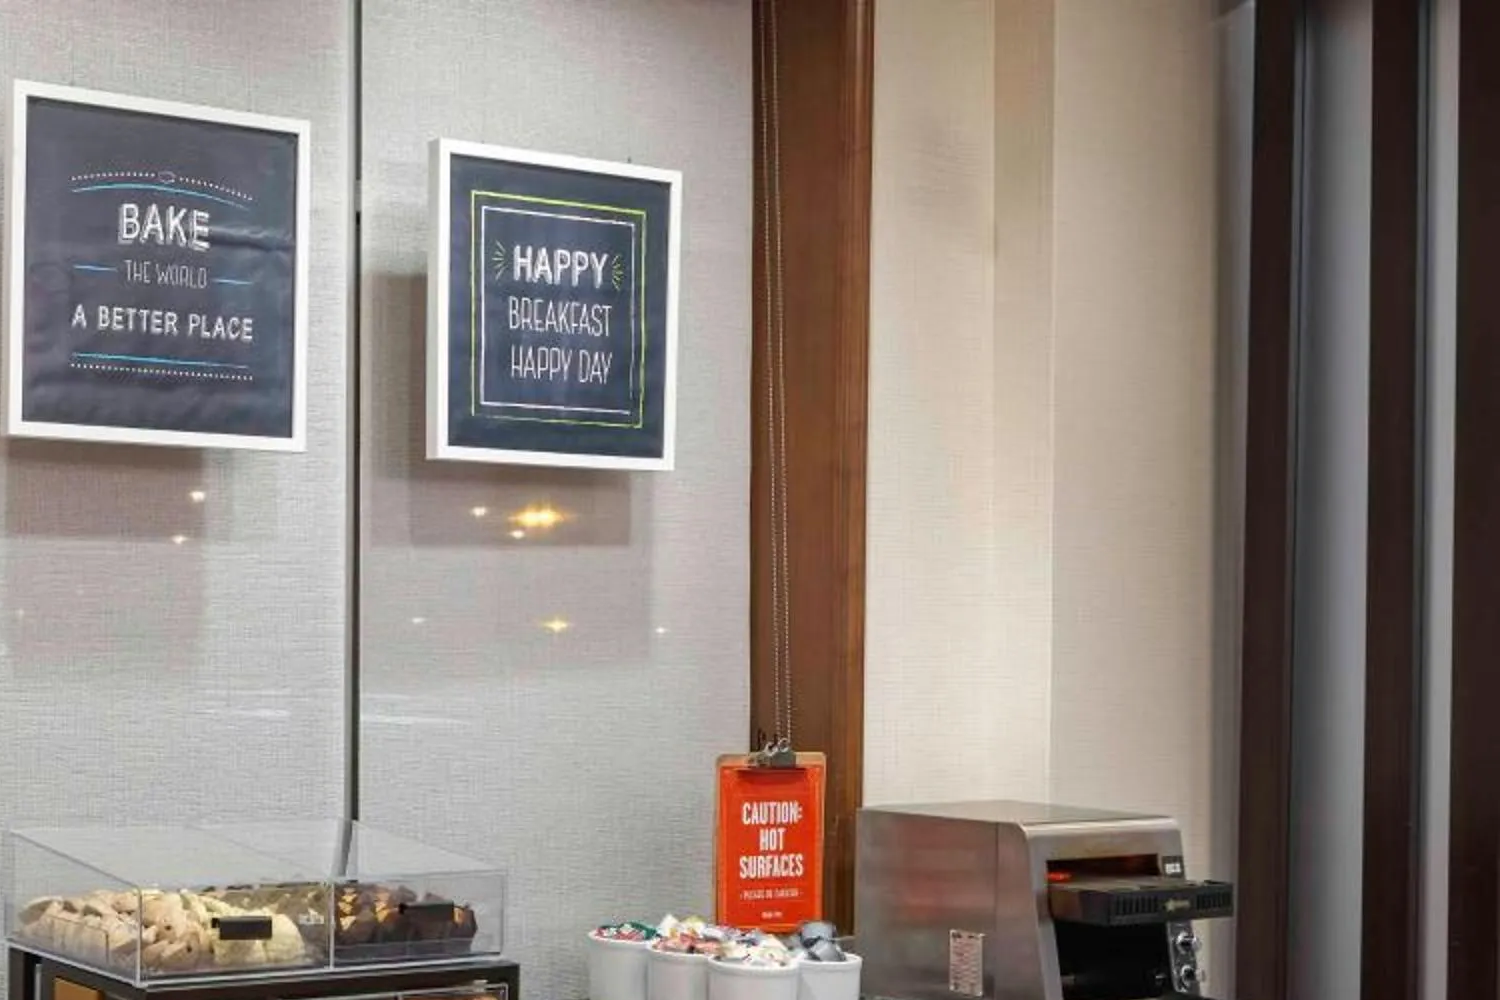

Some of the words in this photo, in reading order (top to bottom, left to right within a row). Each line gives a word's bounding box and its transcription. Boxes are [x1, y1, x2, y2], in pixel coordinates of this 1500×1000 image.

[118, 202, 211, 251] BAKE
[124, 260, 151, 284] THE
[155, 263, 208, 288] WORLD
[512, 245, 610, 289] HAPPY
[71, 304, 87, 328] A
[97, 305, 179, 336] BETTER
[188, 313, 253, 341] PLACE
[508, 296, 612, 337] BREAKFAST
[511, 345, 573, 383] HAPPY
[578, 349, 613, 384] DAY
[742, 800, 803, 825] CAUTION:
[759, 827, 786, 851] HOT
[739, 854, 804, 879] SURFACES
